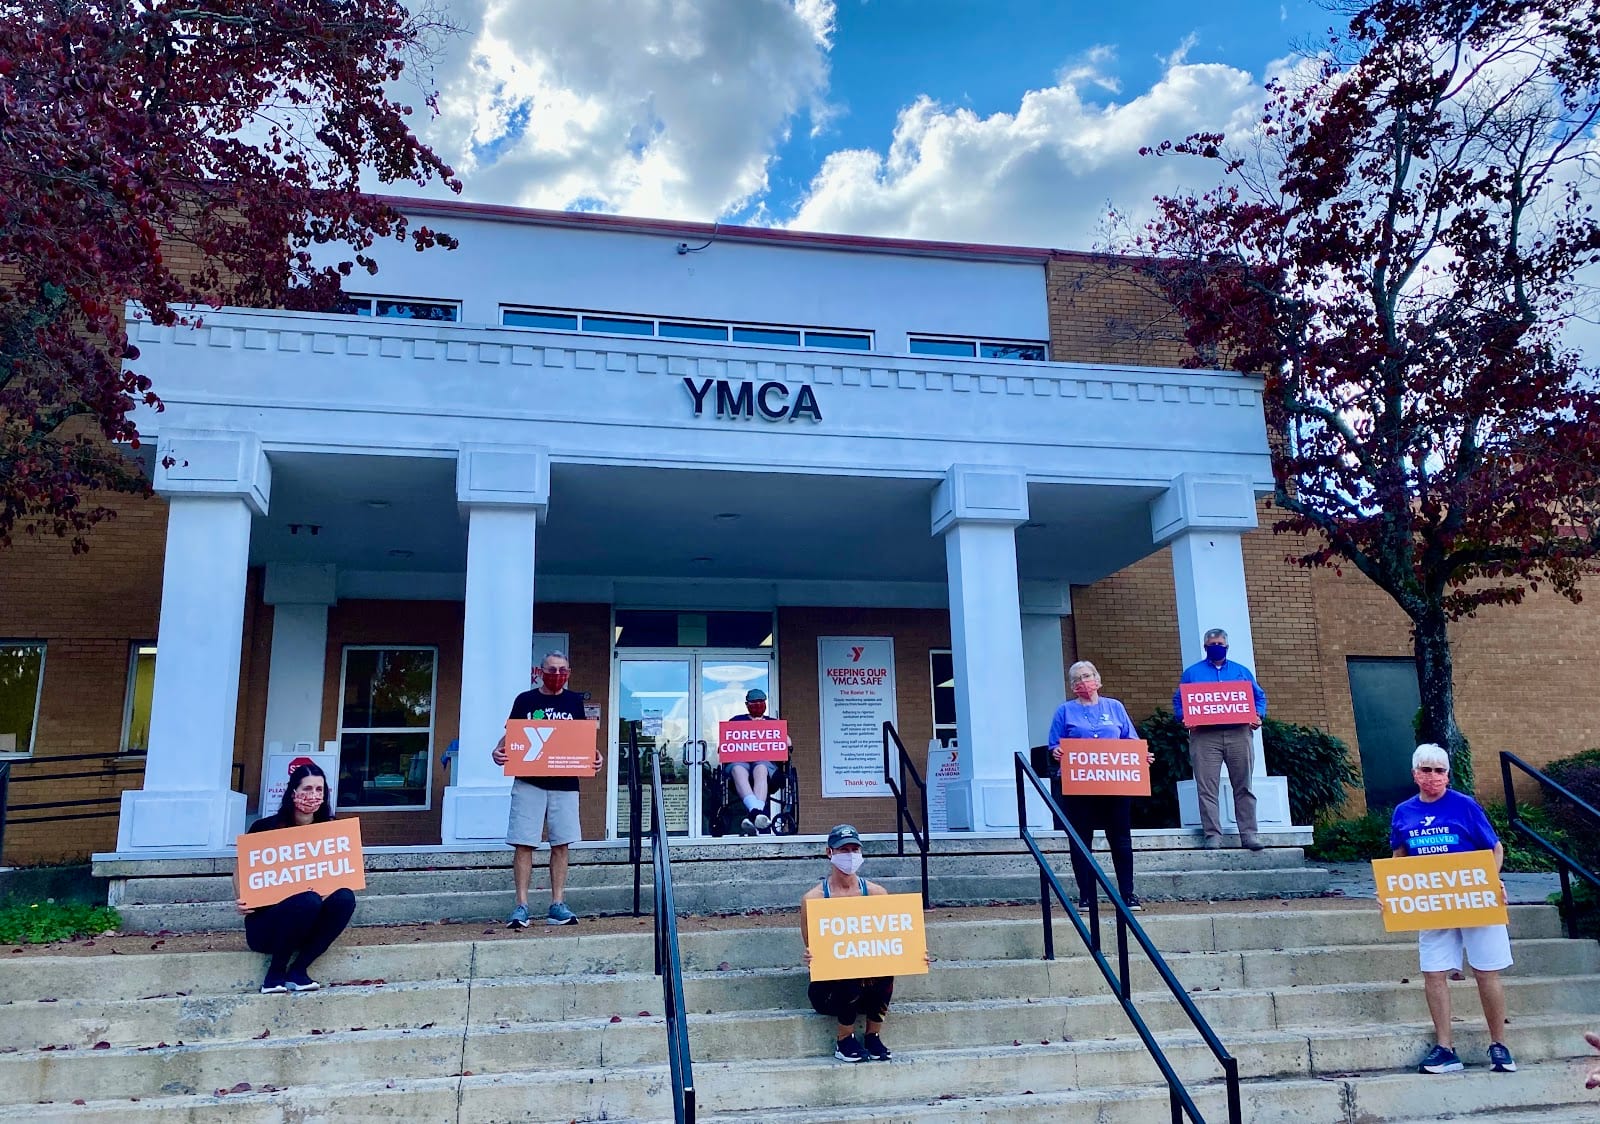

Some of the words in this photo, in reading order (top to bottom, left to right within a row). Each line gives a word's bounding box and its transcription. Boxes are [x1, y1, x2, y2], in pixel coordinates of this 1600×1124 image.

[683, 377, 822, 423] YMCA
[826, 668, 865, 677] KEEPING
[867, 668, 887, 677] OUR
[832, 677, 859, 686] YMCA
[860, 677, 883, 686] SAFE
[1188, 691, 1247, 703] FOREVER
[1188, 705, 1201, 715] IN
[1203, 703, 1250, 714] SERVICE
[546, 712, 573, 720] YMCA
[725, 729, 781, 741] FOREVER
[510, 742, 525, 750] the
[523, 727, 554, 761] Y
[720, 742, 786, 752] CONNECTED
[1069, 751, 1140, 765] FOREVER
[1070, 769, 1141, 782] LEARNING
[1409, 829, 1419, 837] BE
[1421, 827, 1449, 836] ACTIVE
[1417, 836, 1455, 845] INVOLVED
[249, 836, 351, 867] FOREVER
[1417, 845, 1449, 854] BELONG
[248, 858, 356, 890] GRATEFUL
[1386, 868, 1488, 892] FOREVER
[1385, 890, 1498, 914] TOGETHER
[819, 913, 913, 936] FOREVER
[833, 938, 903, 959] CARING
